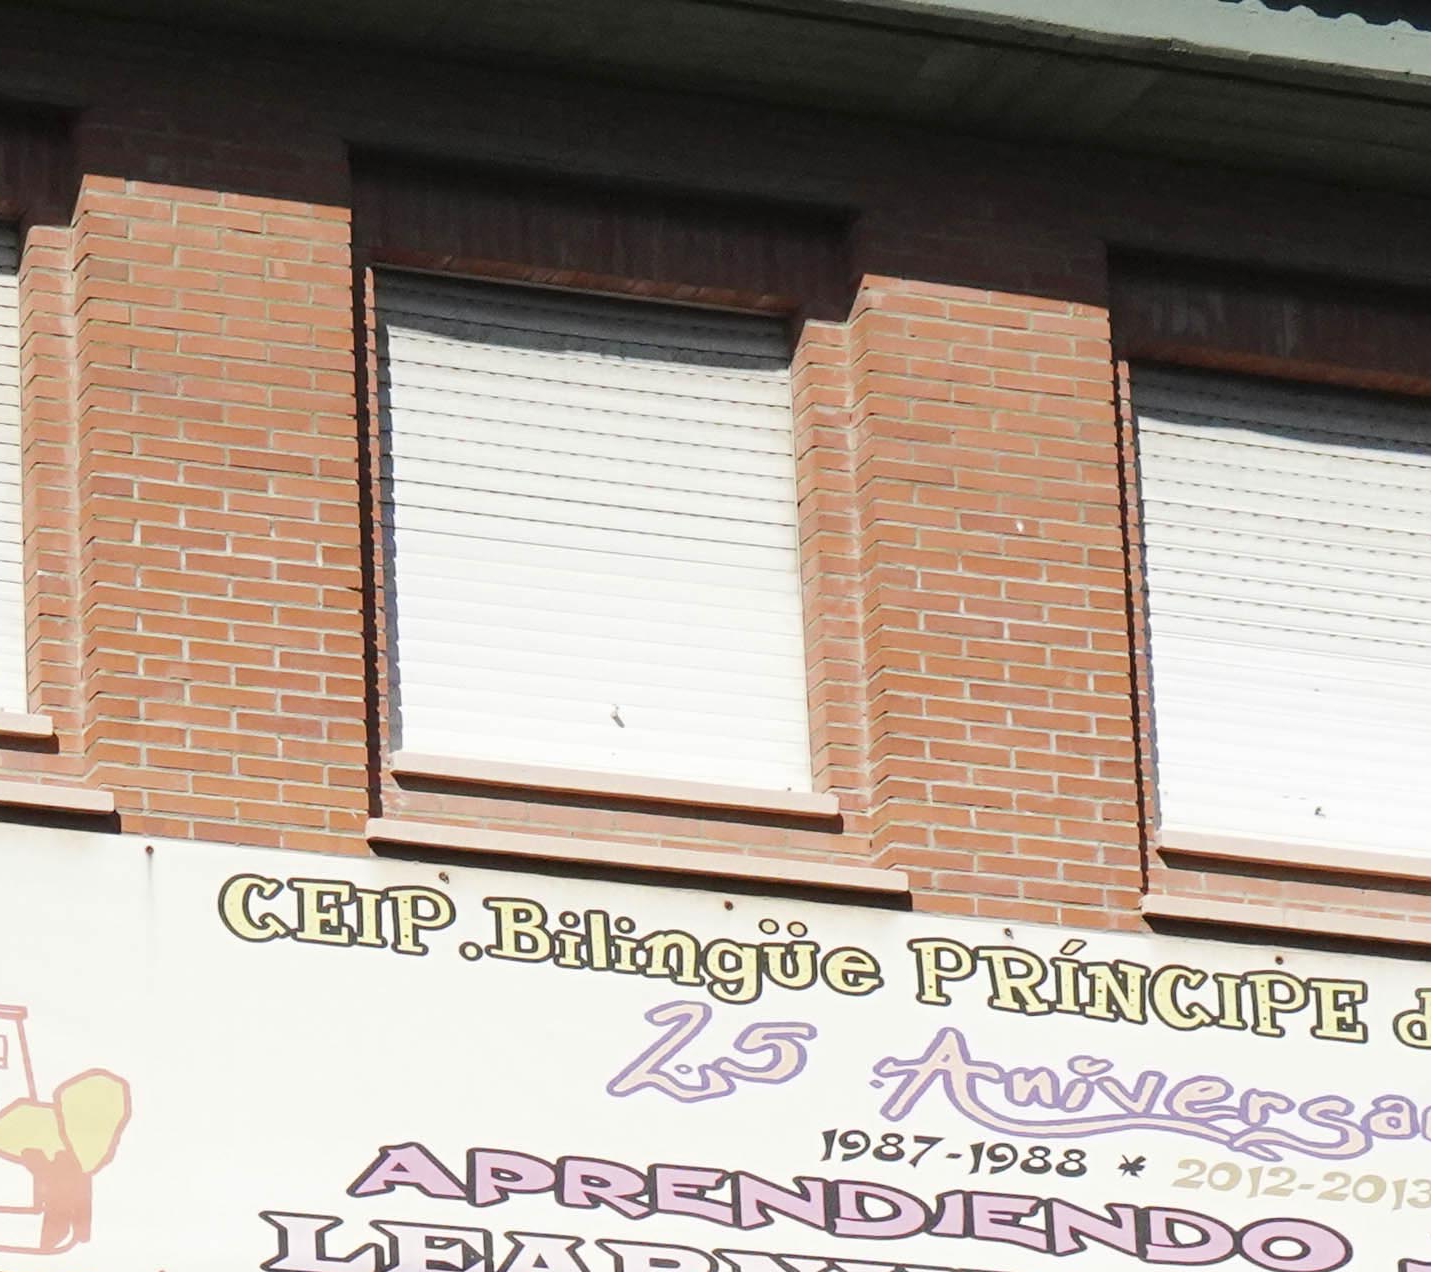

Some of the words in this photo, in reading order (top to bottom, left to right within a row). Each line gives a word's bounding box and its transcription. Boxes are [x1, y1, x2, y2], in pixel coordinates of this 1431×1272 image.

[907, 937, 1370, 1044] PRÍNCIPE
[605, 999, 818, 1104] 25
[821, 1128, 1089, 1178] 1987-1988
